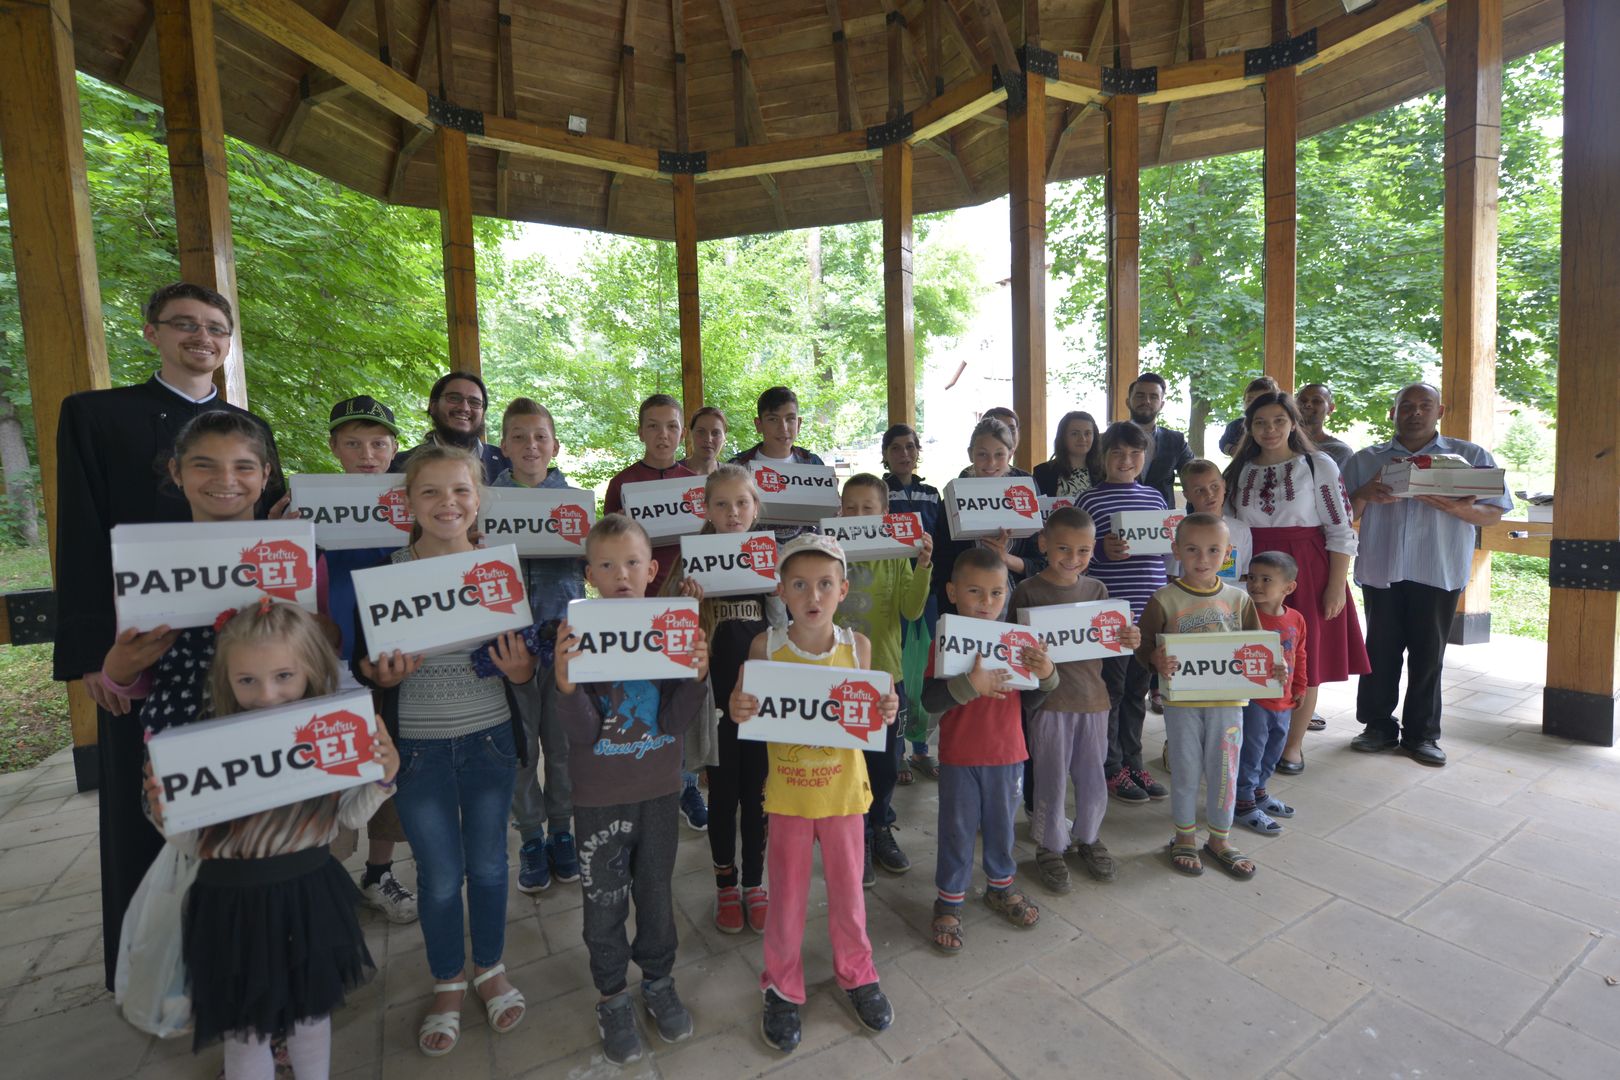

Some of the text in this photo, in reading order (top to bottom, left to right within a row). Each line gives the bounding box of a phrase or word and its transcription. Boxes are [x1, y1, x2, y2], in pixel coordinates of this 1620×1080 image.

[256, 545, 298, 561] Pentru
[311, 719, 357, 738] Pentru
[777, 764, 842, 777] HONG KONG
